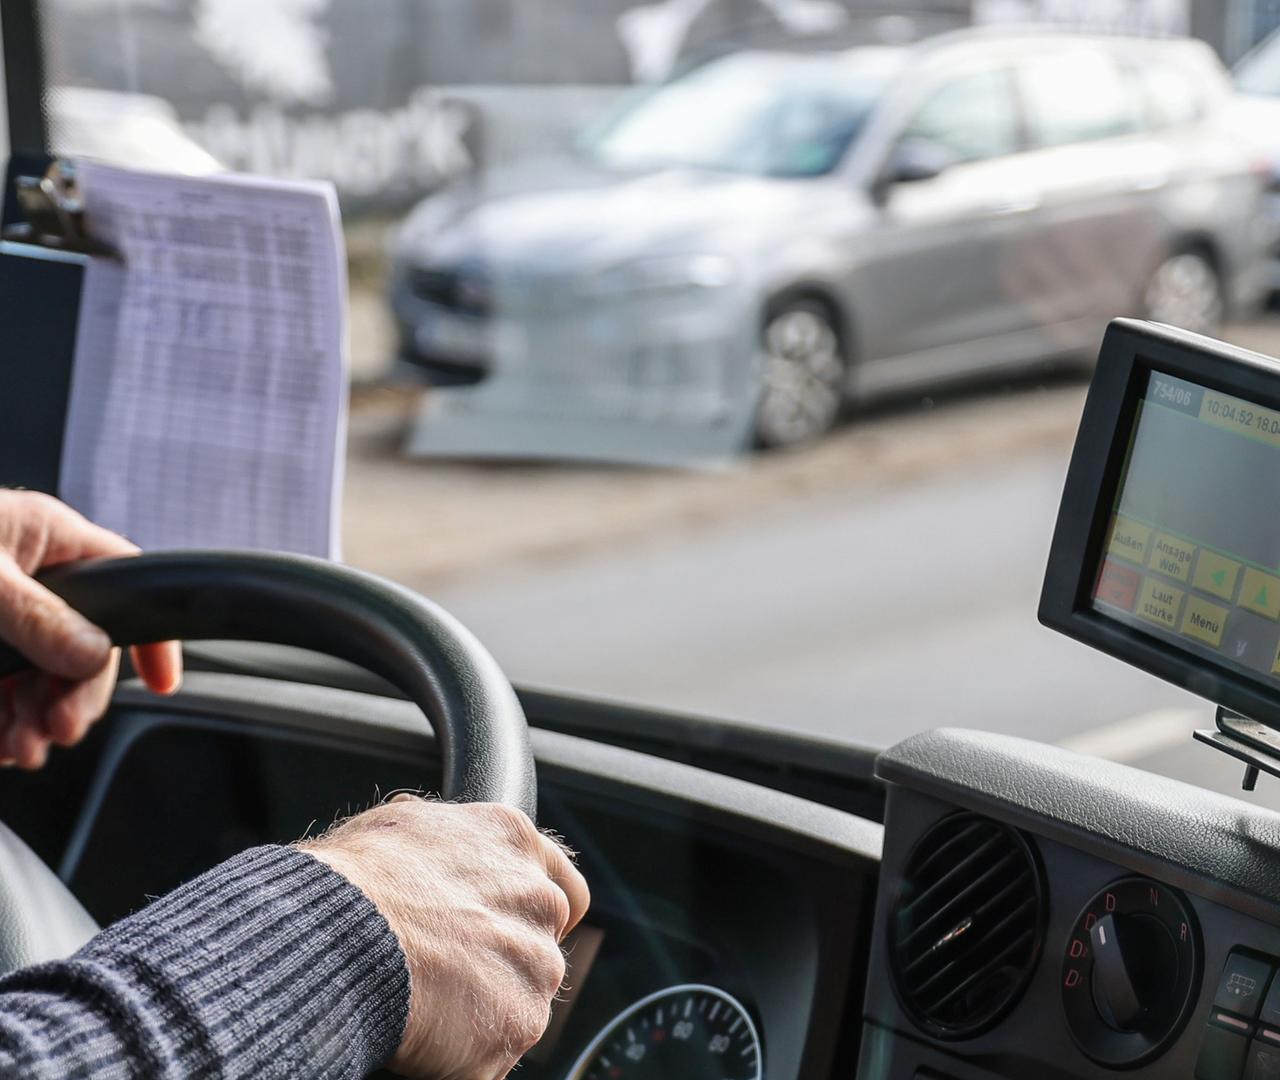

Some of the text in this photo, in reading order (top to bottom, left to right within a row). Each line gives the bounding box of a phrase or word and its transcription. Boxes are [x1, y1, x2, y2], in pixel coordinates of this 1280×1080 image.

[1153, 381, 1192, 406] 754/06
[1207, 399, 1253, 426] 10:04:52
[1156, 540, 1192, 562] Ansage
[1152, 586, 1173, 605] Laut
[1105, 893, 1117, 912] D
[1180, 922, 1188, 942] R
